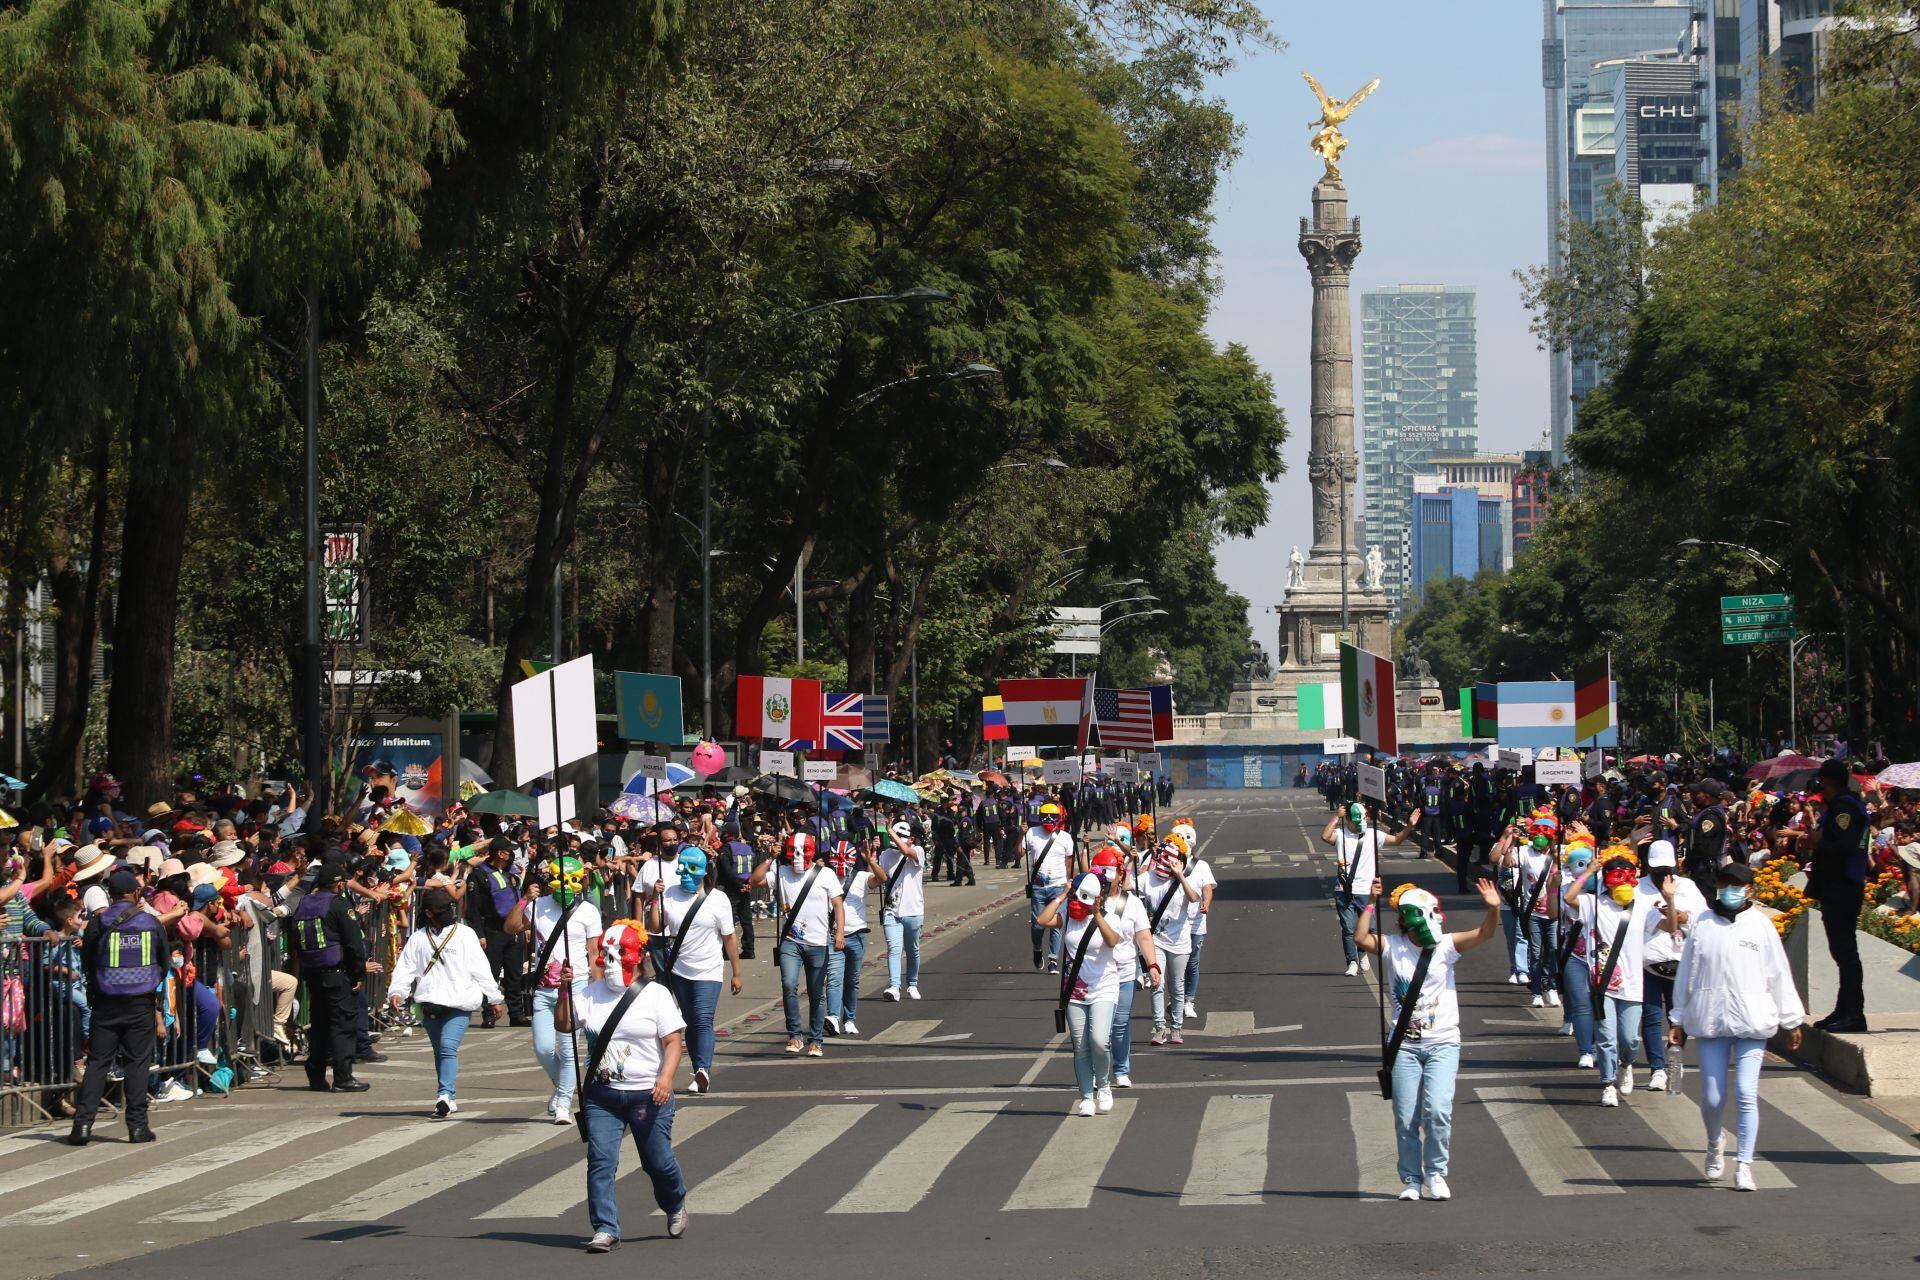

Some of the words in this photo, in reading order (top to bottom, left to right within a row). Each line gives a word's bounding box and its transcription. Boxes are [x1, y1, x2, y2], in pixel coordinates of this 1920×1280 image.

[1742, 597, 1765, 606] NIZA
[1737, 615, 1751, 624] RIO
[1754, 614, 1776, 623] TIBER
[382, 737, 431, 746] infinitum
